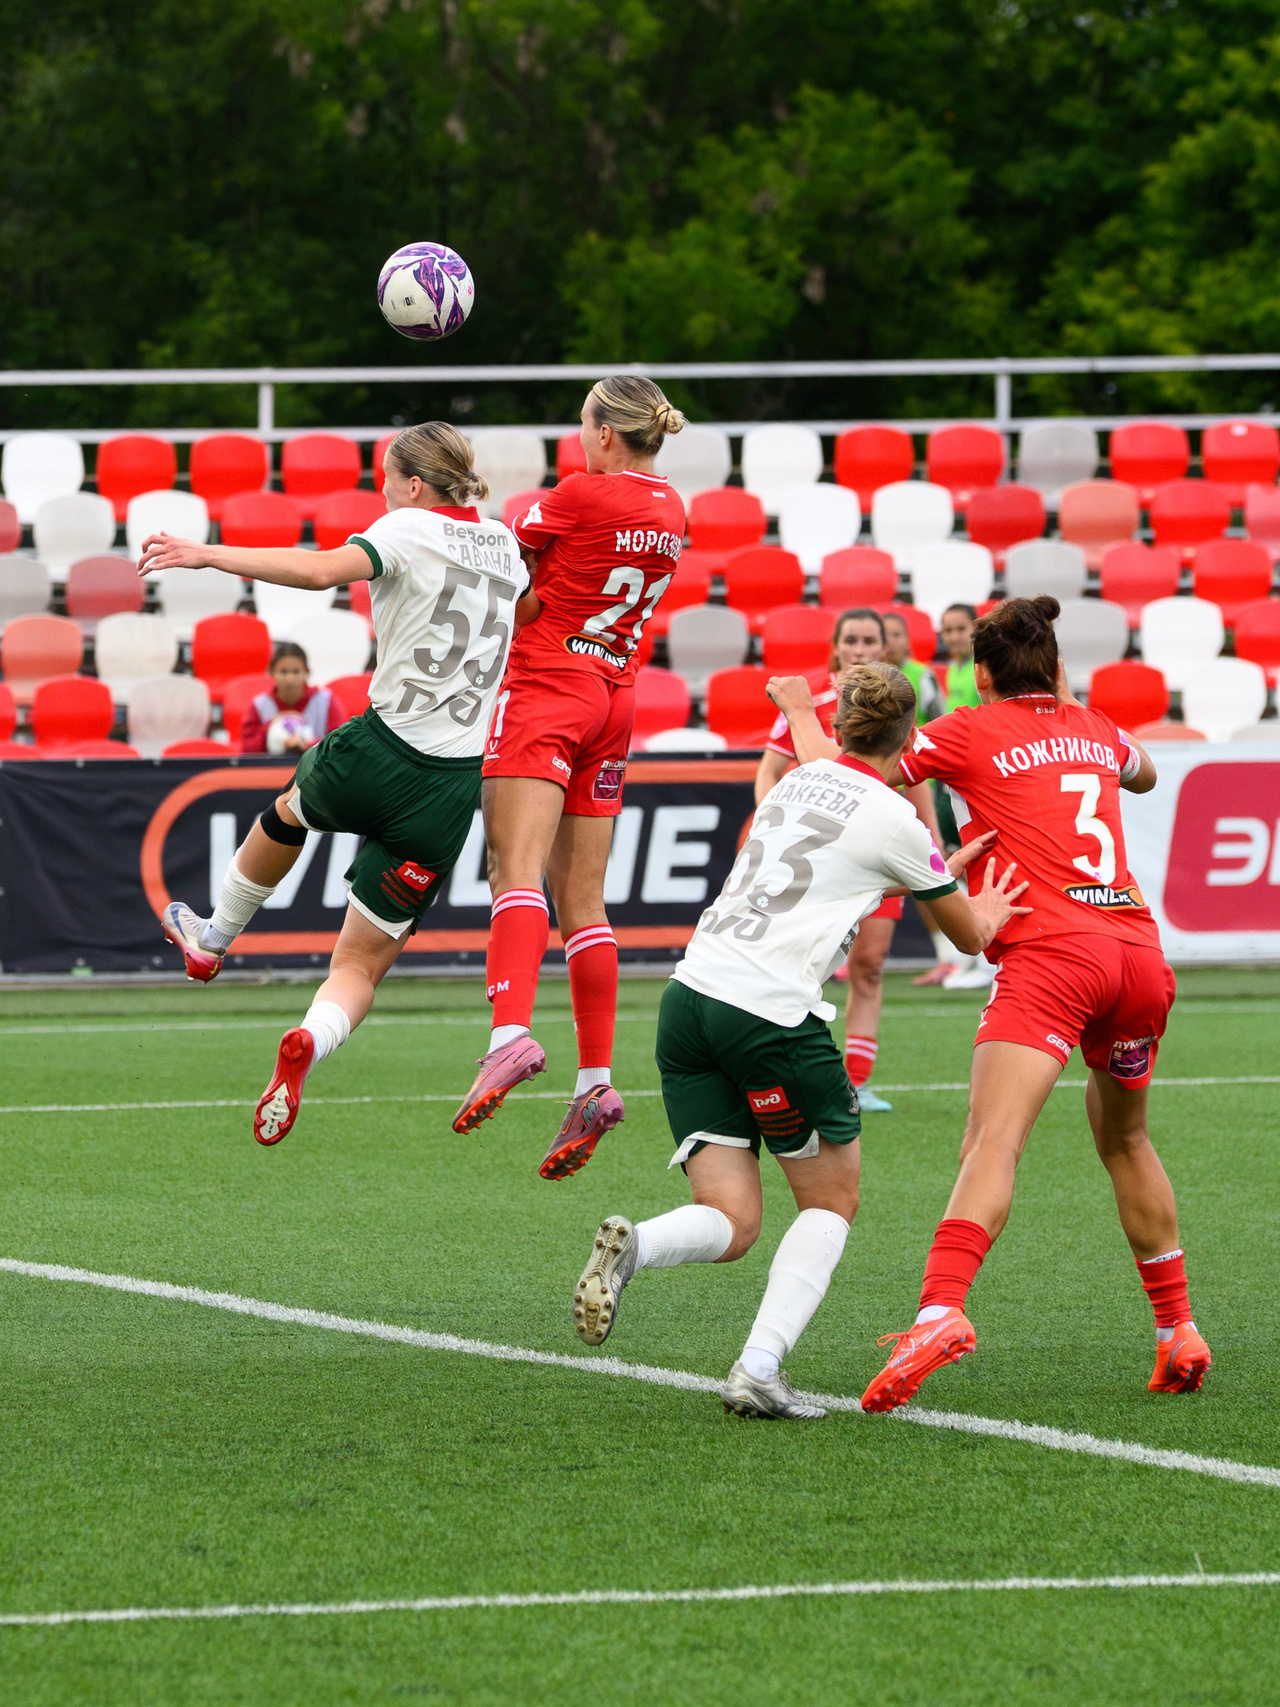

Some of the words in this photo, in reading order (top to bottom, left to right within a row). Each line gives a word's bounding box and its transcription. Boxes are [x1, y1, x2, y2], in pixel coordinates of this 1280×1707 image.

[413, 566, 517, 690] 55
[579, 565, 673, 653] 21
[789, 766, 867, 795] BetBoom
[1060, 773, 1116, 886] 3
[720, 805, 846, 914] 63
